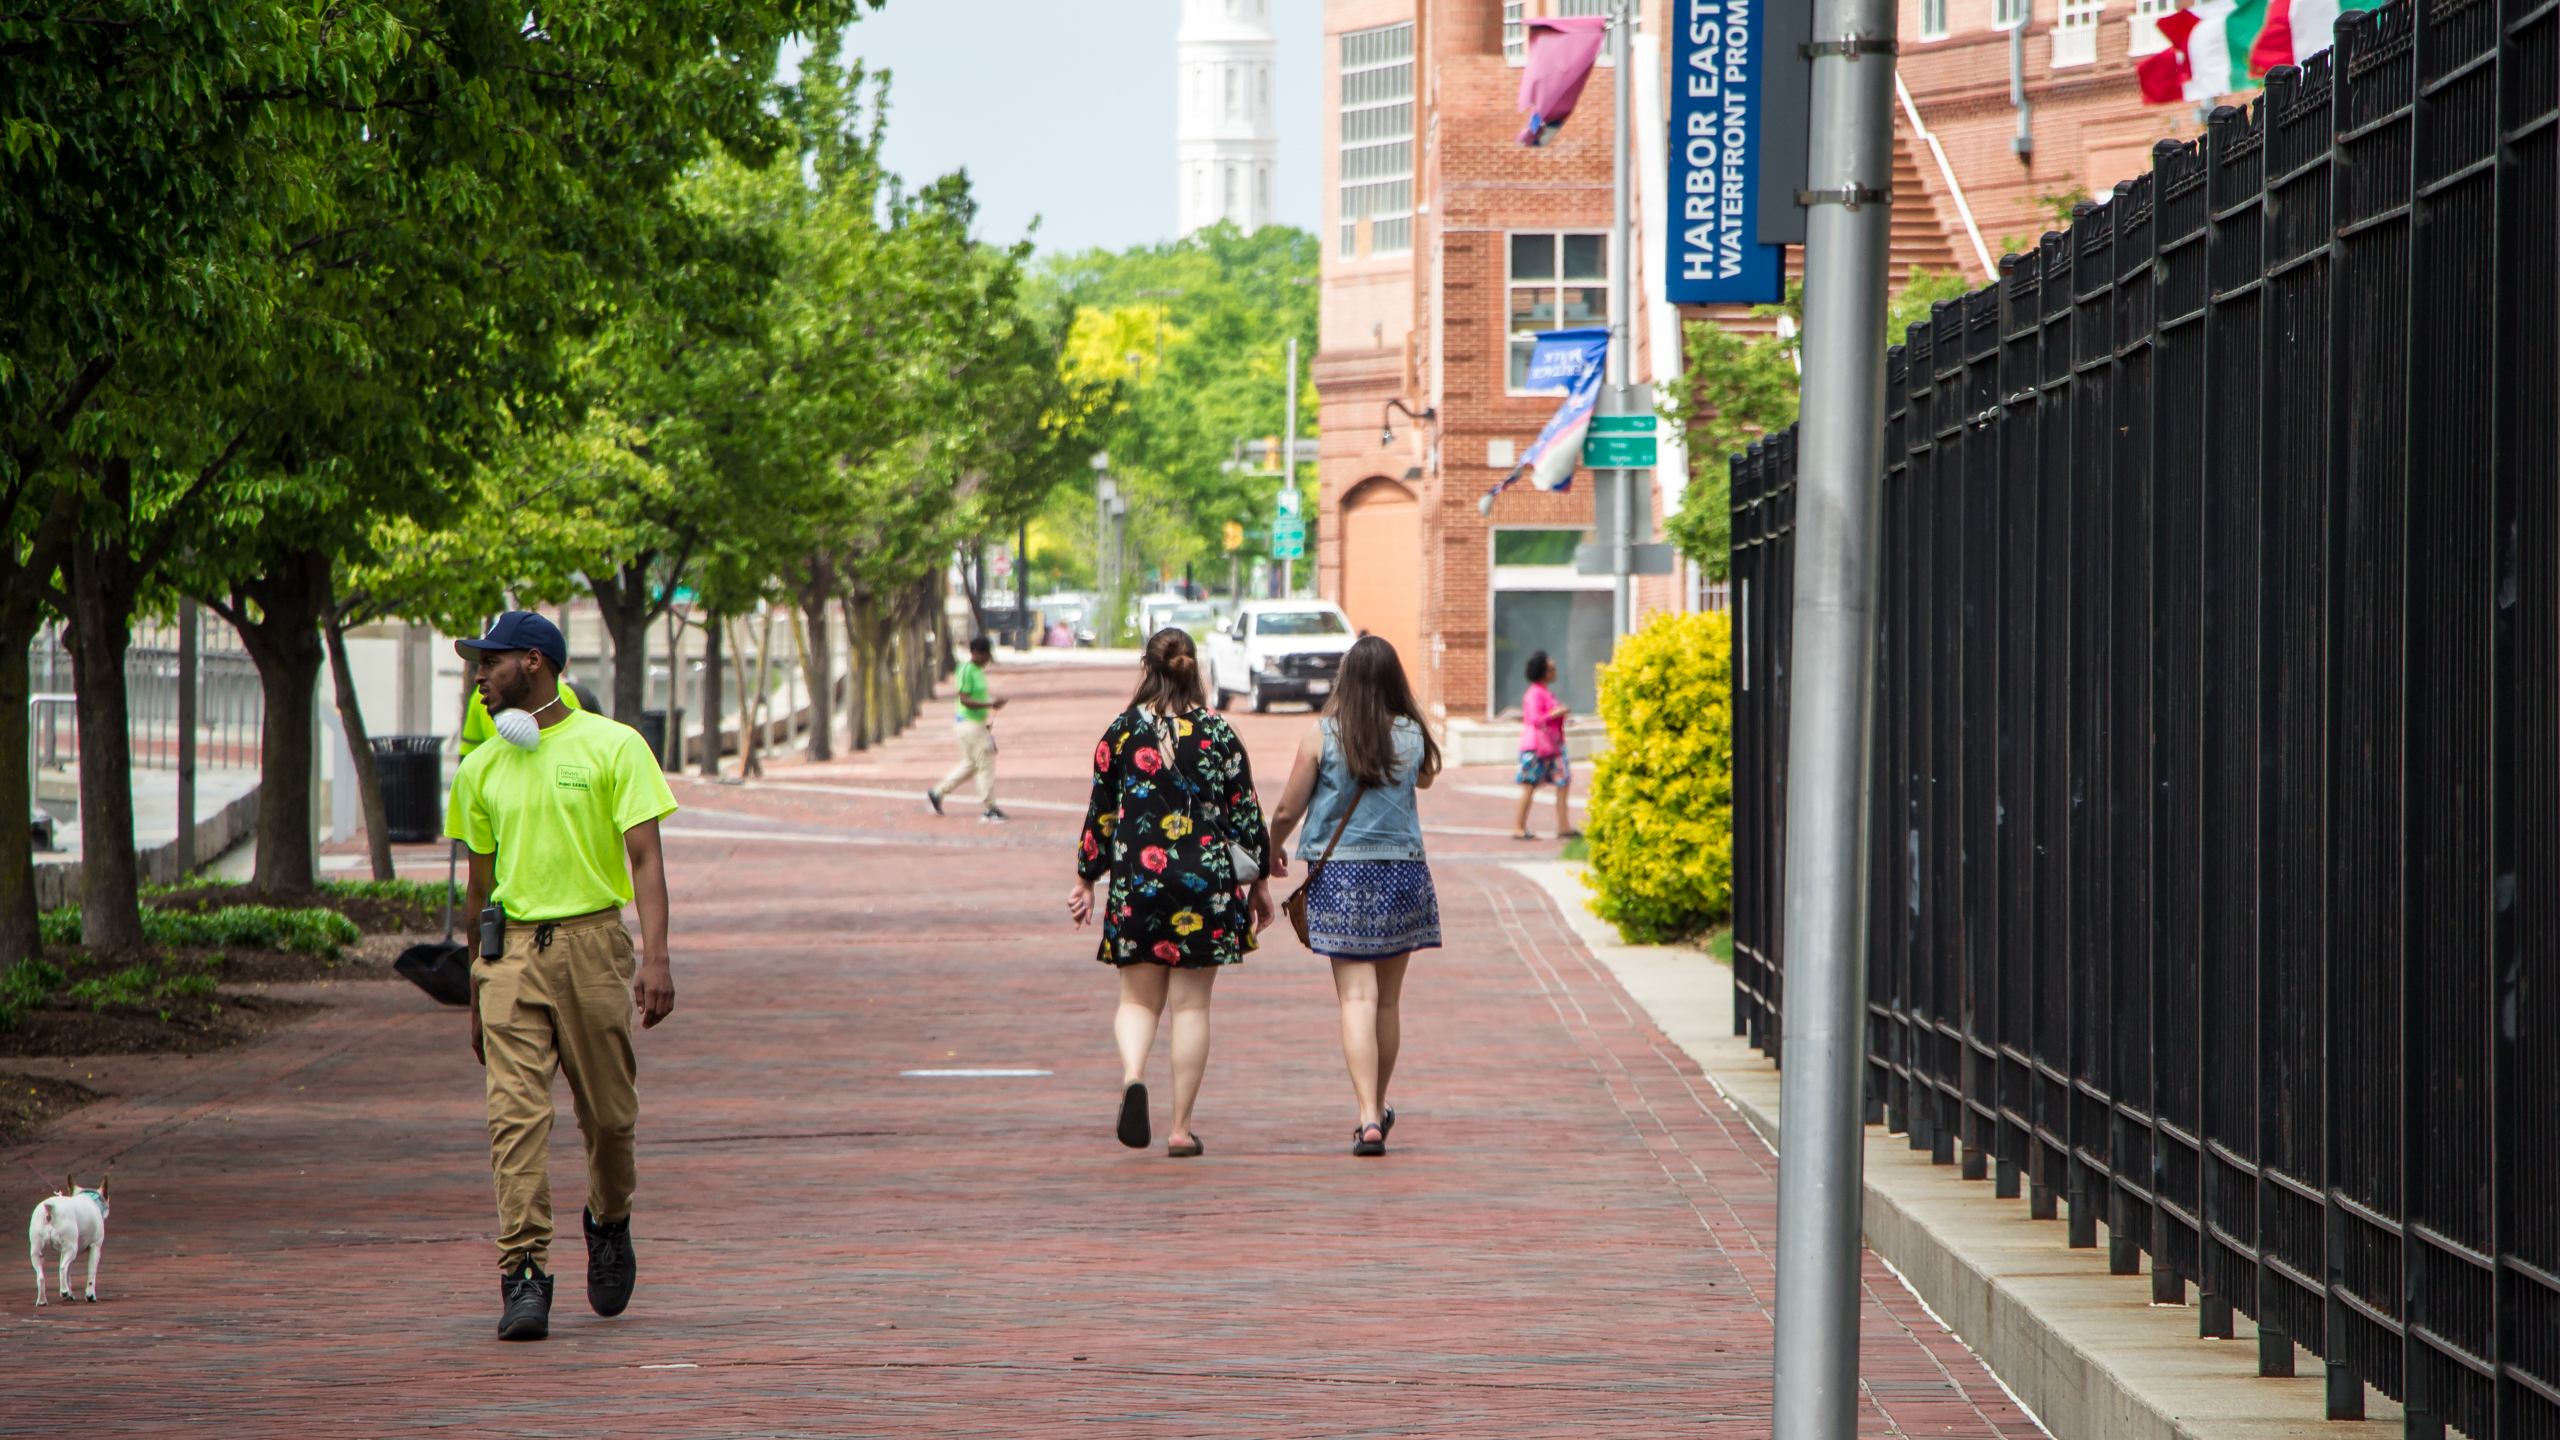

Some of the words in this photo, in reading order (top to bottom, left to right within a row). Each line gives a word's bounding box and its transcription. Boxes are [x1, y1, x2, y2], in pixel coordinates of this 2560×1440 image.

[1689, 0, 1721, 97] EAST
[1724, 0, 1749, 83] PROM
[1684, 112, 1718, 280] HARBOR
[1720, 89, 1747, 280] WATERFRONT
